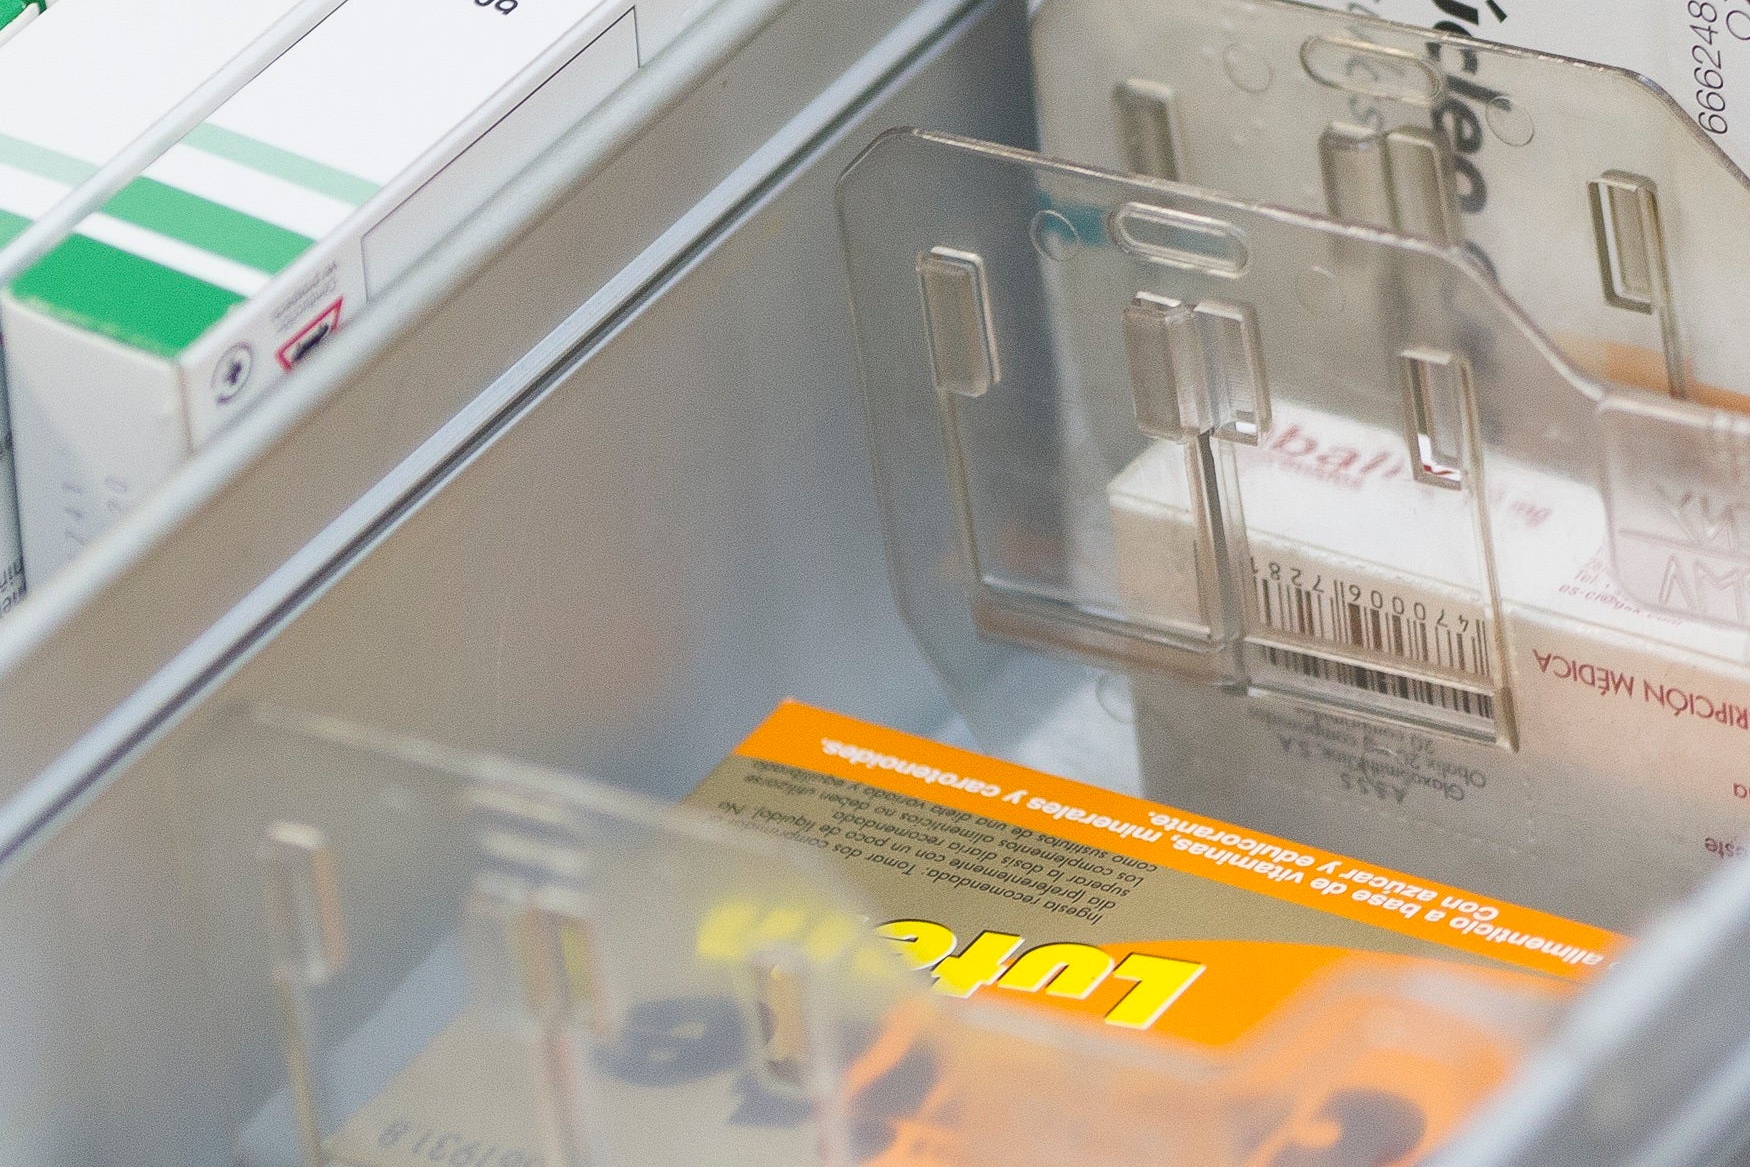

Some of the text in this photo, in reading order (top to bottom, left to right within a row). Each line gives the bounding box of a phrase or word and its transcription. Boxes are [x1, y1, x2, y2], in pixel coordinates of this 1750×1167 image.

[1347, 582, 1471, 634] 470006
[1532, 648, 1634, 696] MÉDICA
[818, 791, 870, 814] deben
[874, 805, 896, 818] no
[930, 803, 972, 823] dieta
[817, 823, 841, 839] de
[898, 811, 995, 845] alimenticios
[975, 815, 1007, 831] una
[1010, 826, 1033, 840] de
[844, 829, 889, 848] poco
[890, 841, 912, 855] un
[1036, 833, 1109, 859] sustitutos
[818, 739, 1604, 966] alimenticio a base de vitaminas, minerales y carotenoides.
[832, 843, 862, 860] dos
[915, 848, 946, 864] con
[997, 837, 1114, 876] complementos
[866, 852, 914, 873] Tomar
[1000, 855, 1044, 876] dosis
[1112, 854, 1158, 872] como
[1147, 810, 1499, 921] Con azúcar y edulcorante.
[923, 866, 1039, 905] recomendada:
[948, 858, 1086, 904] (preferentemente
[1047, 868, 1064, 882] la
[1066, 872, 1130, 897] superar
[1117, 872, 1143, 886] Los
[1042, 899, 1103, 925] Ingesta
[1088, 895, 1116, 912] día
